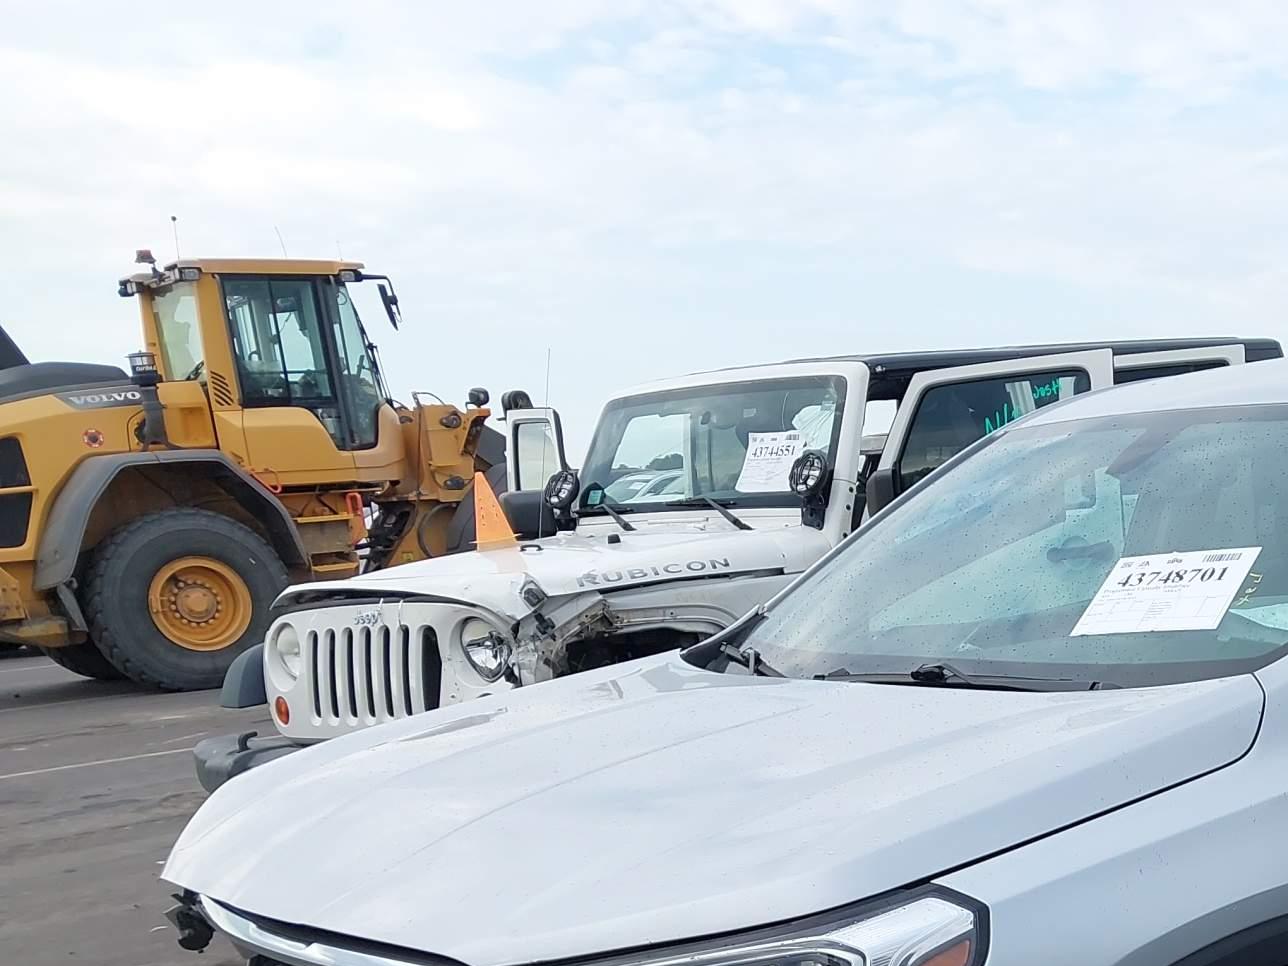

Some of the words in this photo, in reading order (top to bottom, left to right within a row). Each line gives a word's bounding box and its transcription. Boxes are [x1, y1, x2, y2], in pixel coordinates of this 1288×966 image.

[69, 391, 141, 405] VOLVO
[751, 444, 795, 458] 43744551
[576, 558, 730, 587] RUBICON
[1117, 566, 1229, 588] 43748701
